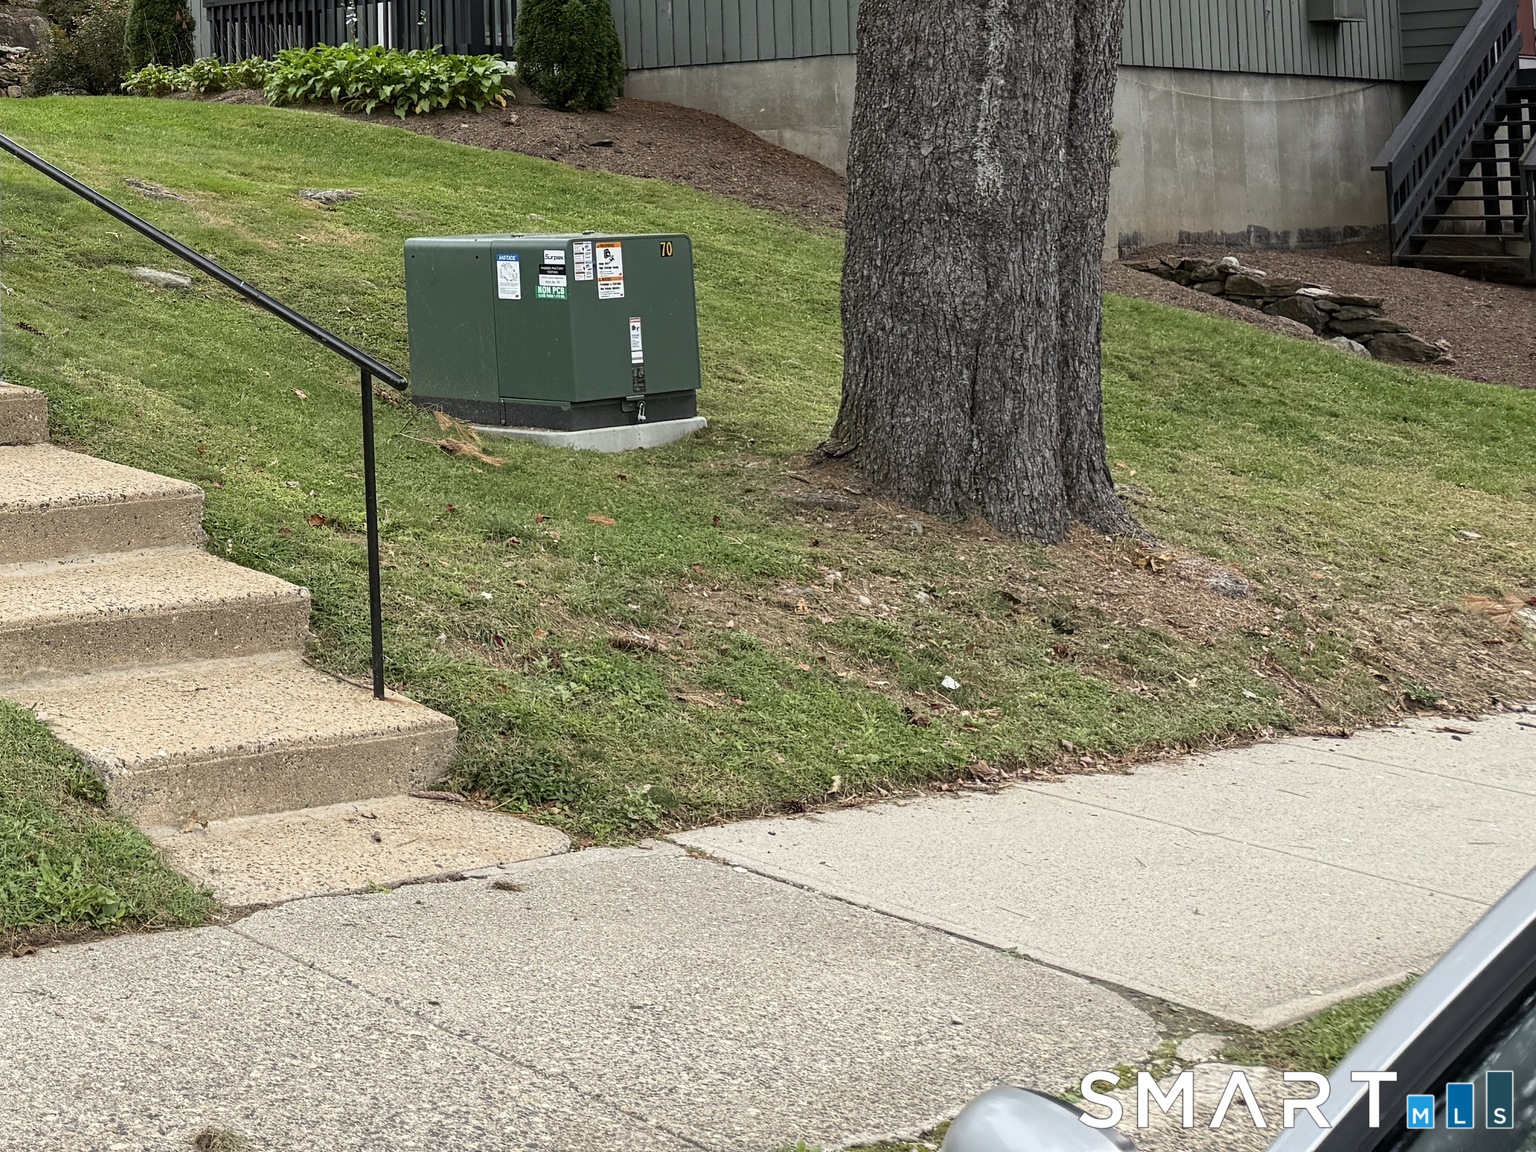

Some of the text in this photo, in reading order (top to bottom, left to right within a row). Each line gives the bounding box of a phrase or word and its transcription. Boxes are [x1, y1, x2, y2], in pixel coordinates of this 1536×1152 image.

[660, 241, 673, 257] 70
[537, 285, 565, 295] NON PCB
